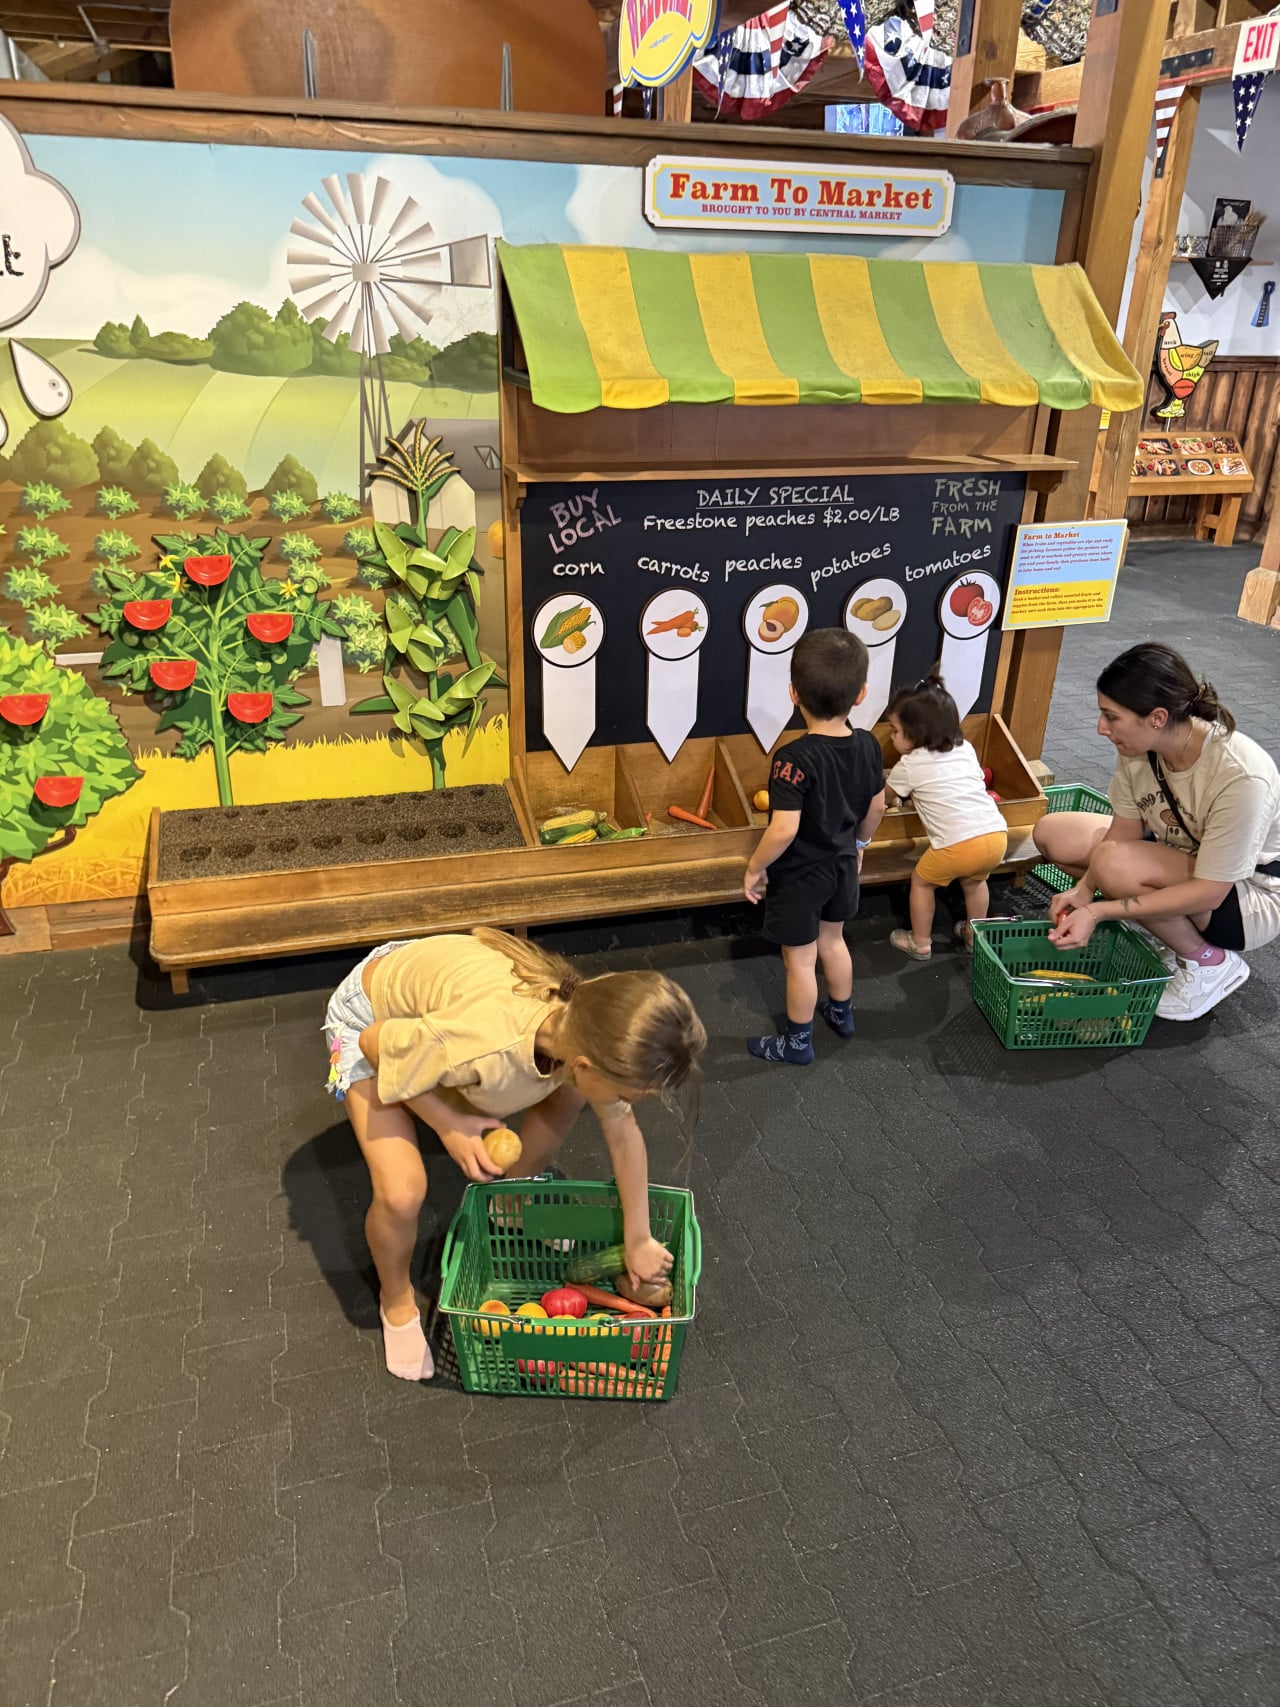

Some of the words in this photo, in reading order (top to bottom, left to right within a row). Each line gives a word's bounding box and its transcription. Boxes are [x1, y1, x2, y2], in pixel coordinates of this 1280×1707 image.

[1243, 21, 1278, 63] EXIT
[669, 172, 760, 202] Farm
[769, 177, 809, 205] To
[817, 179, 933, 210] Market
[701, 203, 752, 215] BROUGHT
[756, 206, 769, 215] TO
[772, 206, 792, 216] YOU
[793, 207, 807, 217] BY
[809, 208, 857, 219] CENTRAL
[858, 210, 902, 221] MARKET
[696, 486, 761, 507] DAILY
[769, 484, 855, 506] SPECIAL
[935, 478, 1001, 502] FRESH
[549, 487, 599, 529] BUY
[643, 512, 738, 531] Freestone
[745, 509, 816, 537] peaches
[822, 505, 900, 529] $2.00/LB
[932, 501, 970, 516] FROM
[975, 500, 998, 512] THE
[548, 504, 622, 555] LOCAL
[931, 515, 993, 539] FARM
[1023, 533, 1043, 541] Farm
[1053, 531, 1080, 539] Market
[552, 561, 605, 576] corn
[637, 556, 710, 583] carrots
[724, 552, 803, 583] peaches
[810, 542, 892, 592] potatoes
[905, 544, 992, 582] tomatoes
